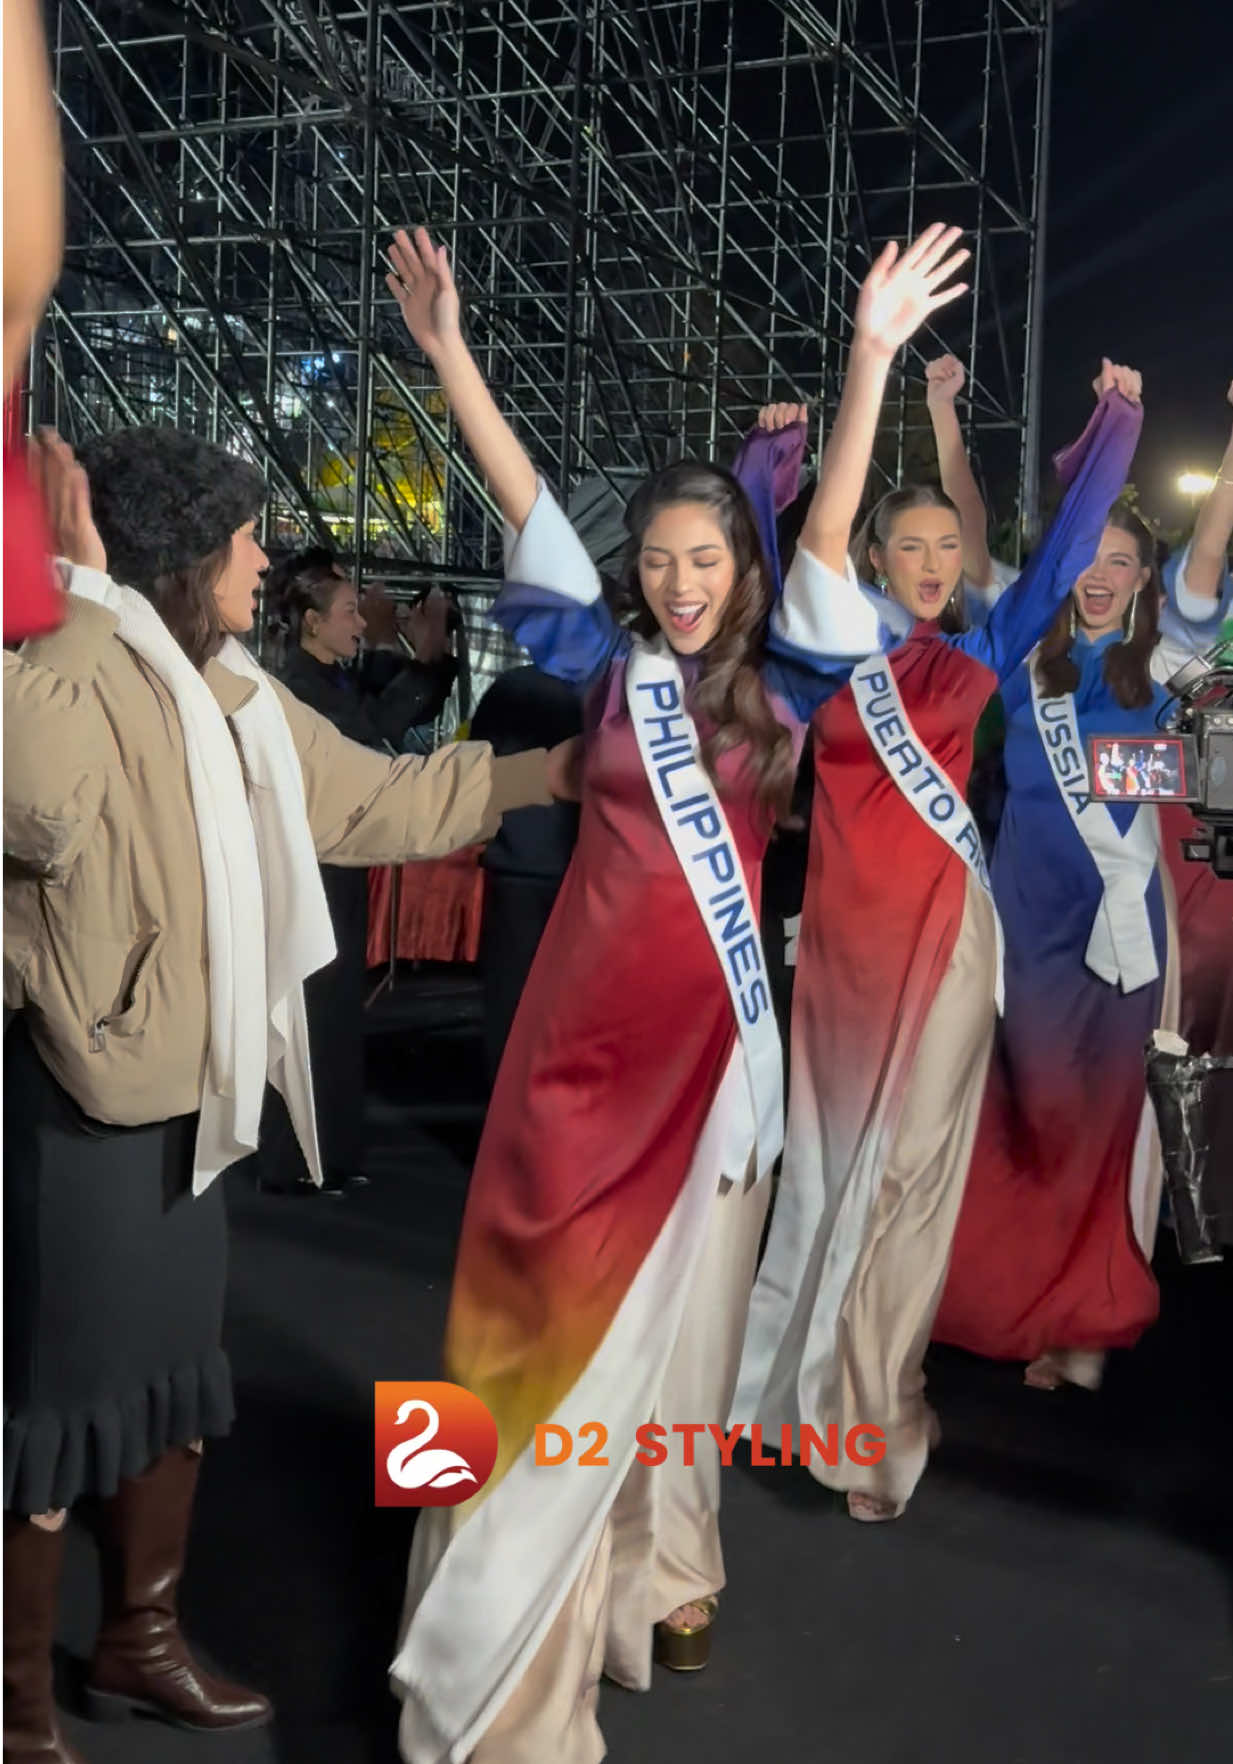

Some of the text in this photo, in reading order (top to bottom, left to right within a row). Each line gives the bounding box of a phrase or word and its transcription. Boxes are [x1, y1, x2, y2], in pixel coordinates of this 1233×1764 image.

[858, 671, 955, 821] PUERTO
[1038, 699, 1092, 815] USSIA
[637, 680, 768, 1025] PHILIPPINES
